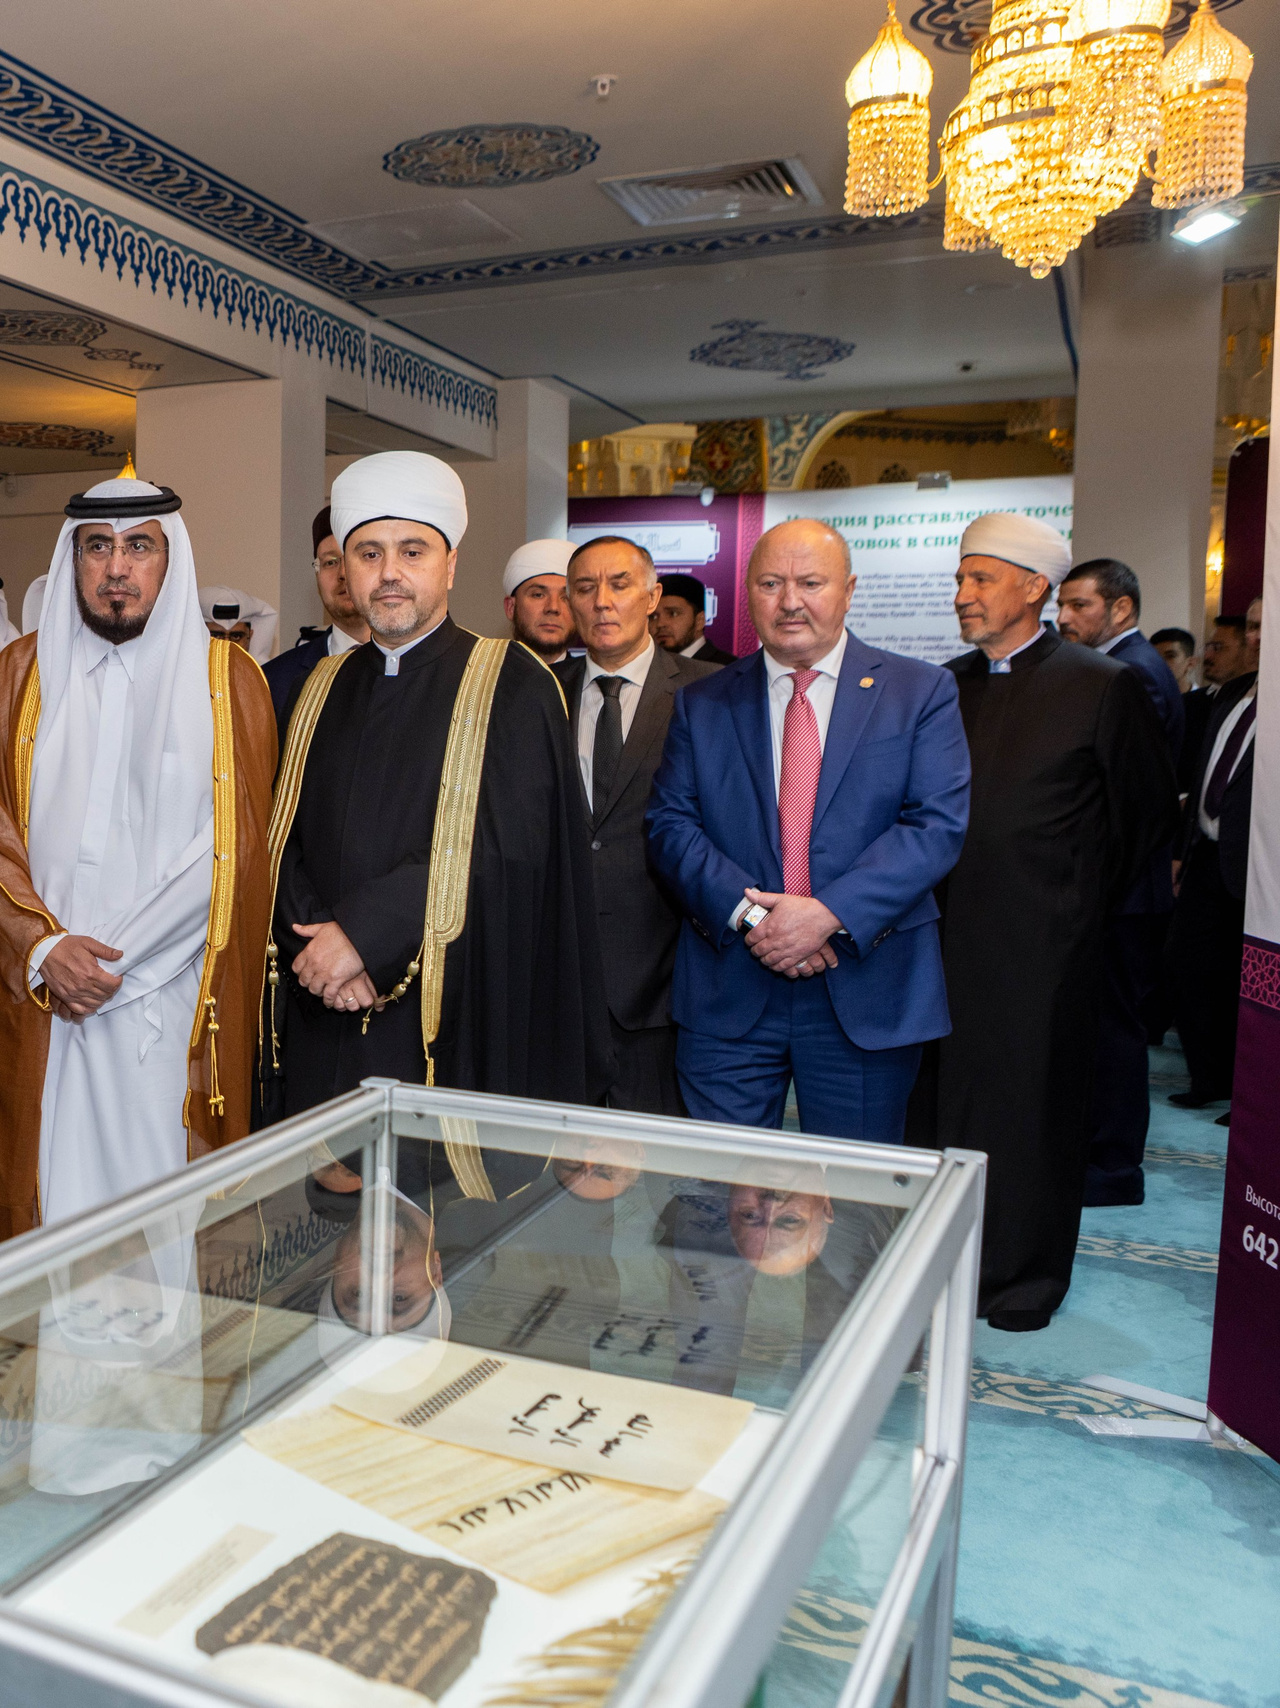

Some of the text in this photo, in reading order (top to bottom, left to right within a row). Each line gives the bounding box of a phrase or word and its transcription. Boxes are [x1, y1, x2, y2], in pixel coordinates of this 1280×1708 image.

[786, 513, 867, 528] ория
[872, 508, 1017, 529] расставле
[906, 536, 917, 548] в
[923, 535, 959, 548] спи
[1245, 1184, 1280, 1220] Высот
[1242, 1224, 1279, 1270] 642
